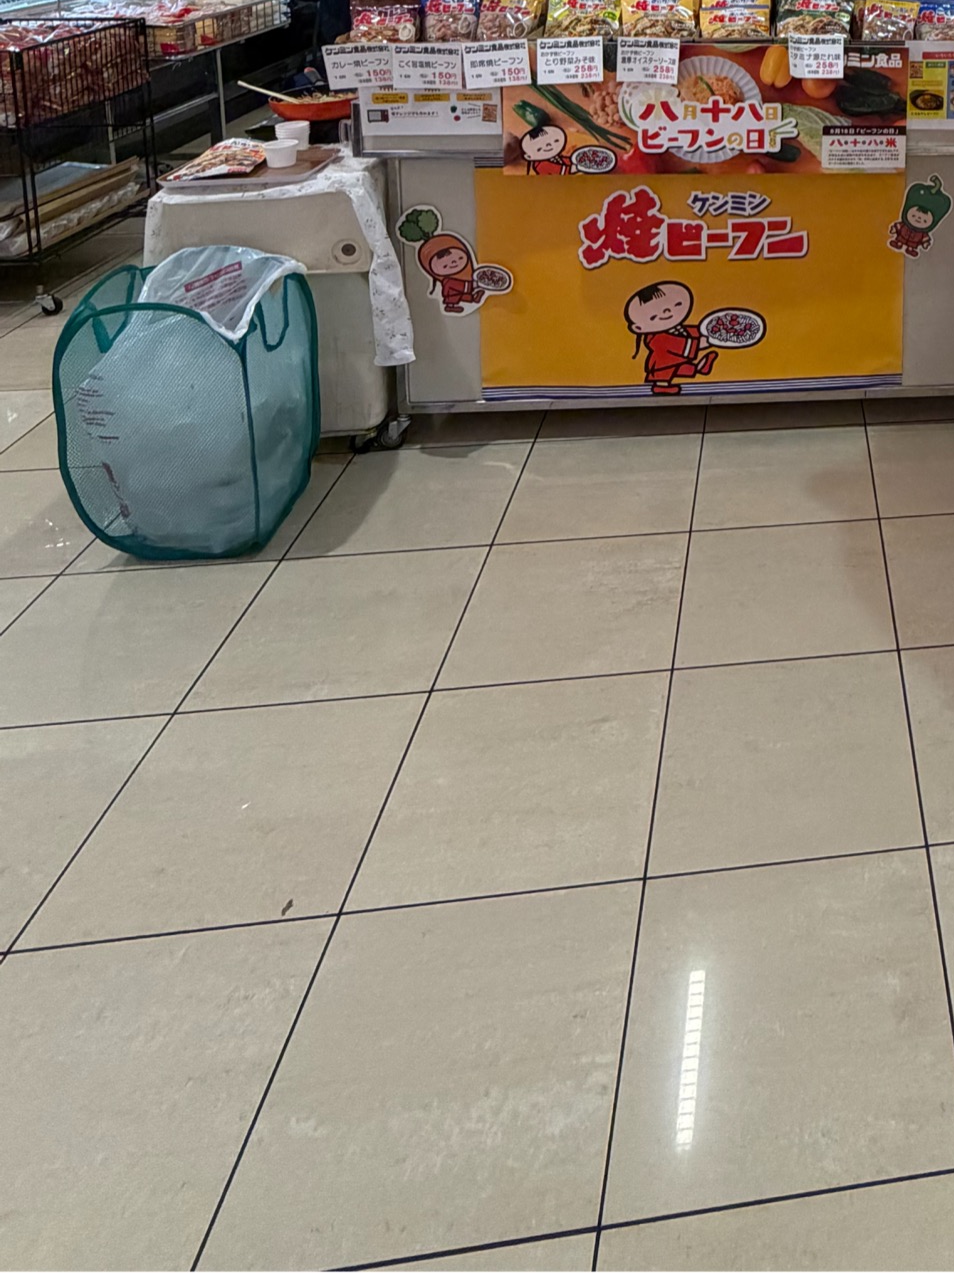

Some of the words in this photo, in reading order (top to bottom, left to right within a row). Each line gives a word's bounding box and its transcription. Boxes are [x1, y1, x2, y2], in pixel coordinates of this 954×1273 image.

[332, 58, 390, 70] カレー焼ビーフン
[844, 52, 903, 68] ミン食品
[638, 99, 778, 123] 八月十八日
[641, 126, 765, 150] ビーフンの日
[688, 192, 769, 214] ケンミン
[582, 189, 805, 266] 焼ビーフン
